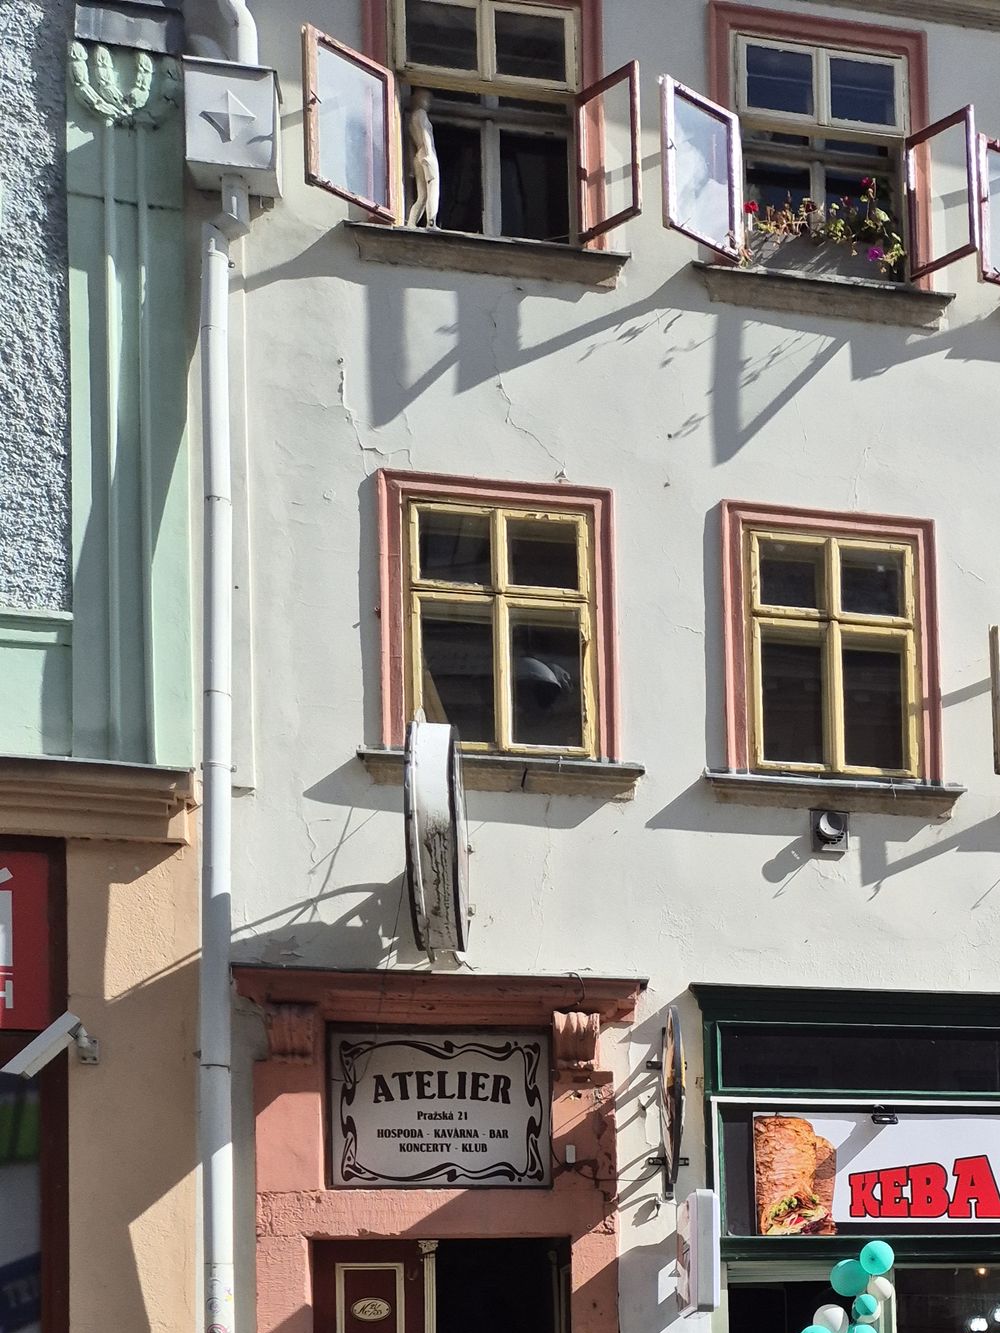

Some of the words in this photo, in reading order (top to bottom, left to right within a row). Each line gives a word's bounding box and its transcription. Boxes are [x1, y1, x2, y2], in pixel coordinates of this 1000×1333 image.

[373, 1070, 512, 1104] ATELIER
[417, 1110, 454, 1121] Pražská
[457, 1111, 468, 1120] 21
[377, 1129, 423, 1139] HOSPODA
[434, 1128, 479, 1138] KAVÁRNA
[489, 1129, 508, 1139] BAR
[399, 1143, 450, 1153] KONCERTY
[461, 1143, 487, 1153] KLUB
